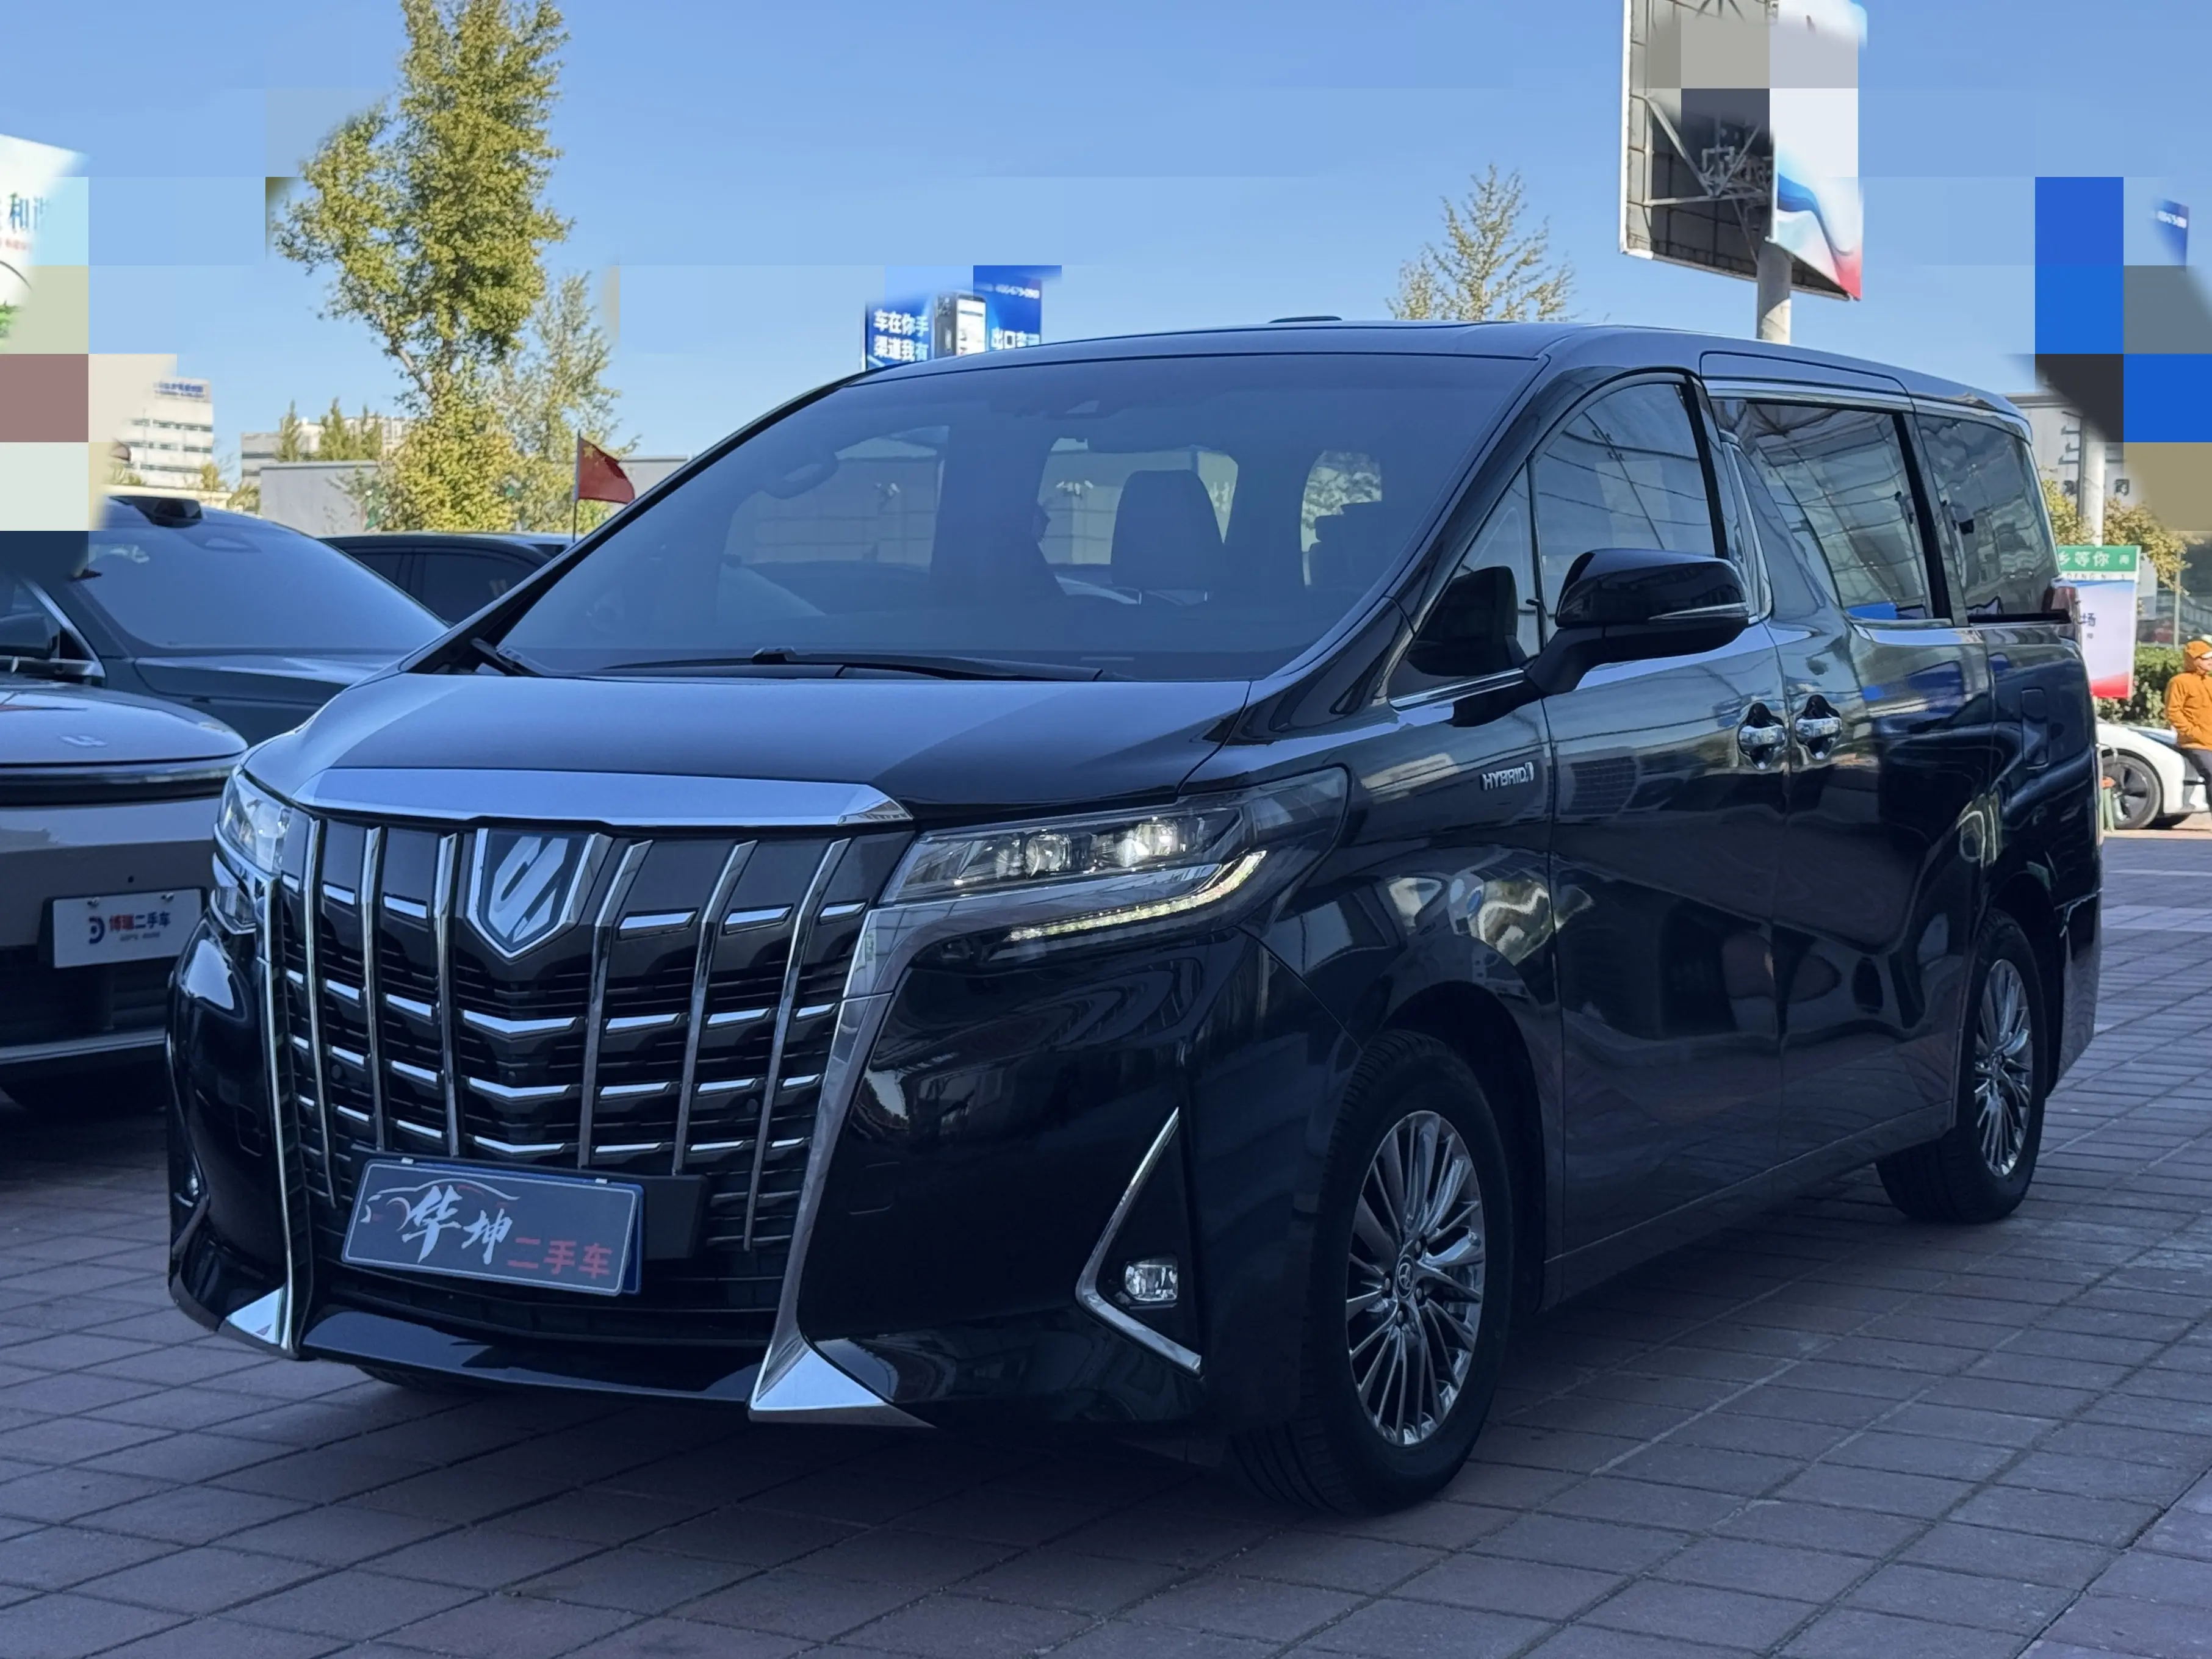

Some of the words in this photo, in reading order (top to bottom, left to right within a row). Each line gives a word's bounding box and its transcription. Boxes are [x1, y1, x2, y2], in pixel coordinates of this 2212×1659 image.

[873, 309, 929, 337] 车在你手
[874, 334, 928, 362] 渠道我有
[1482, 766, 1529, 791] HYBRID
[402, 1184, 513, 1265] 华坤
[506, 1236, 613, 1279] 二手车
